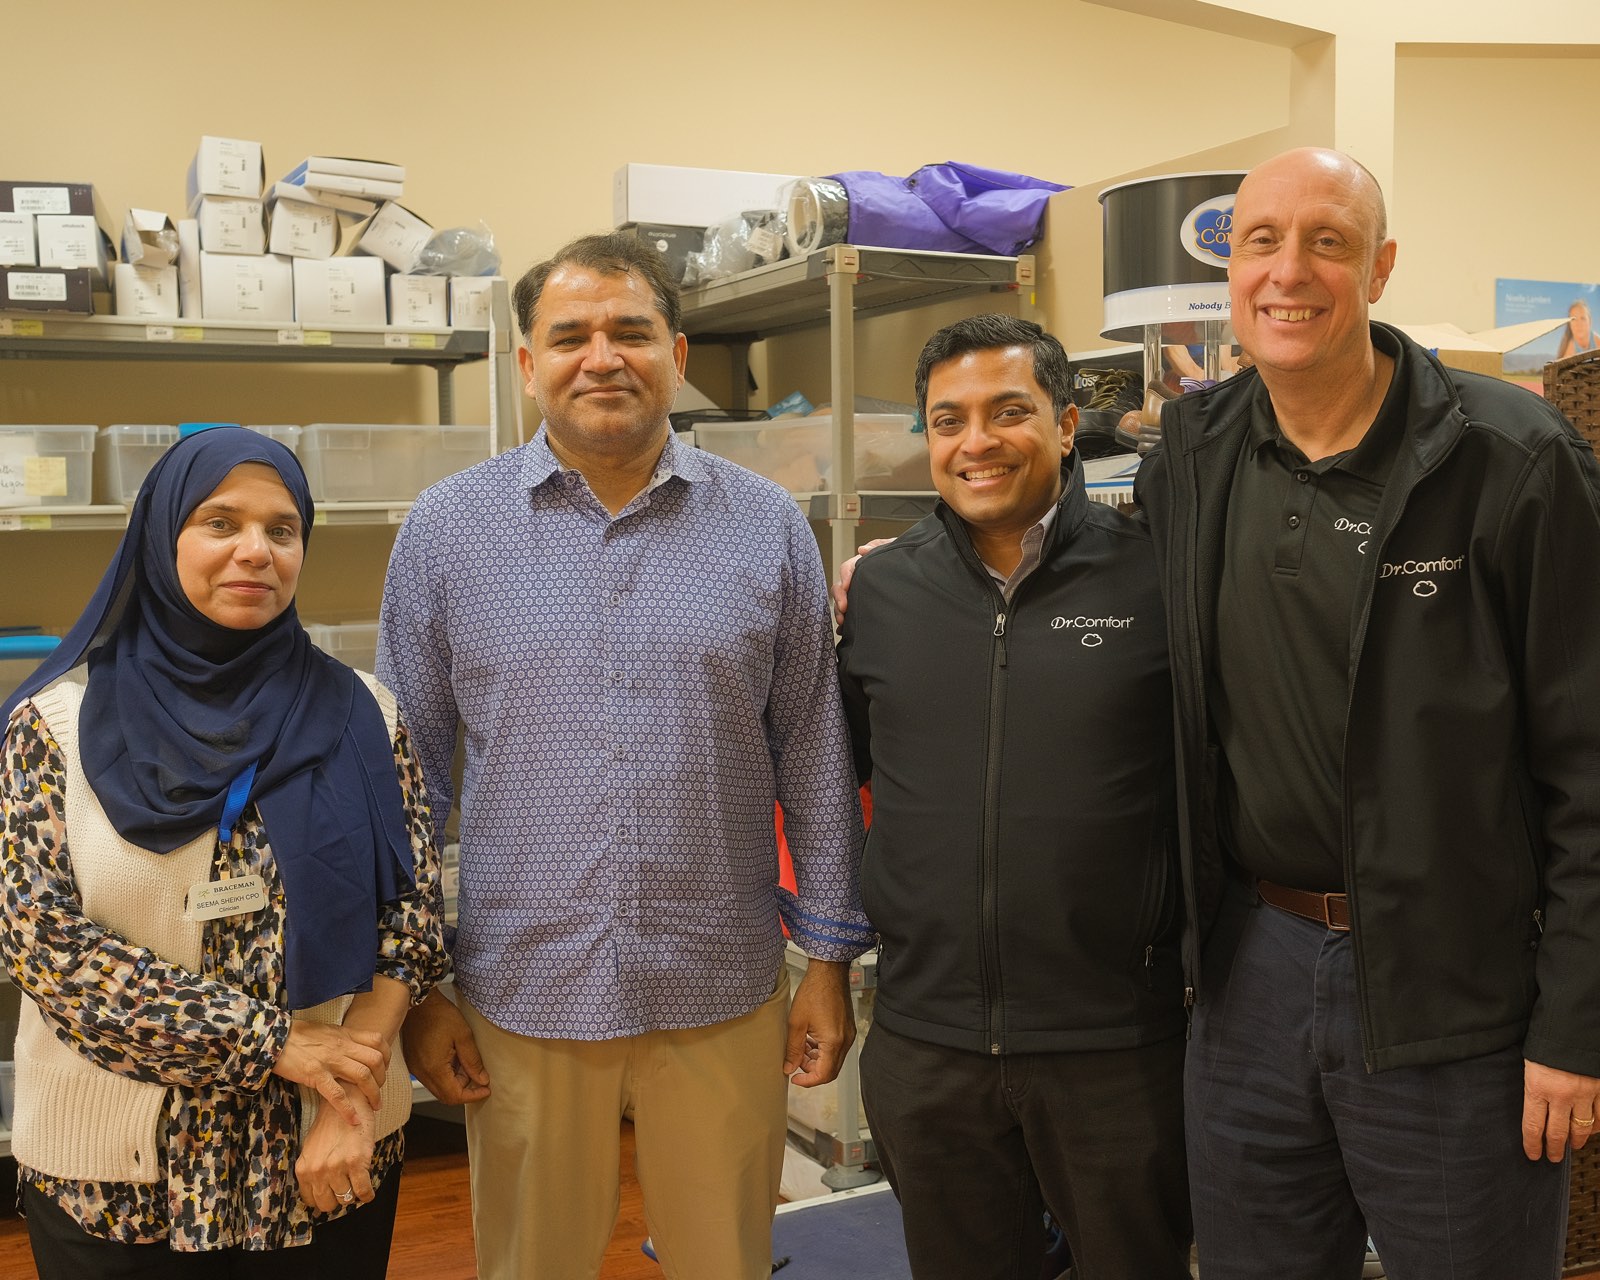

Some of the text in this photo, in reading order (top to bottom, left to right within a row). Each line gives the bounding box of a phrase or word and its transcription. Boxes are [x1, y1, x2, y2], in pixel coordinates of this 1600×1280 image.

[1215, 214, 1232, 230] D
[1188, 301, 1222, 311] Nobody
[213, 881, 255, 893] BRACEMAN
[196, 901, 219, 909] SEEMA
[220, 896, 244, 905] SHEIKH
[219, 905, 239, 913] Clinician
